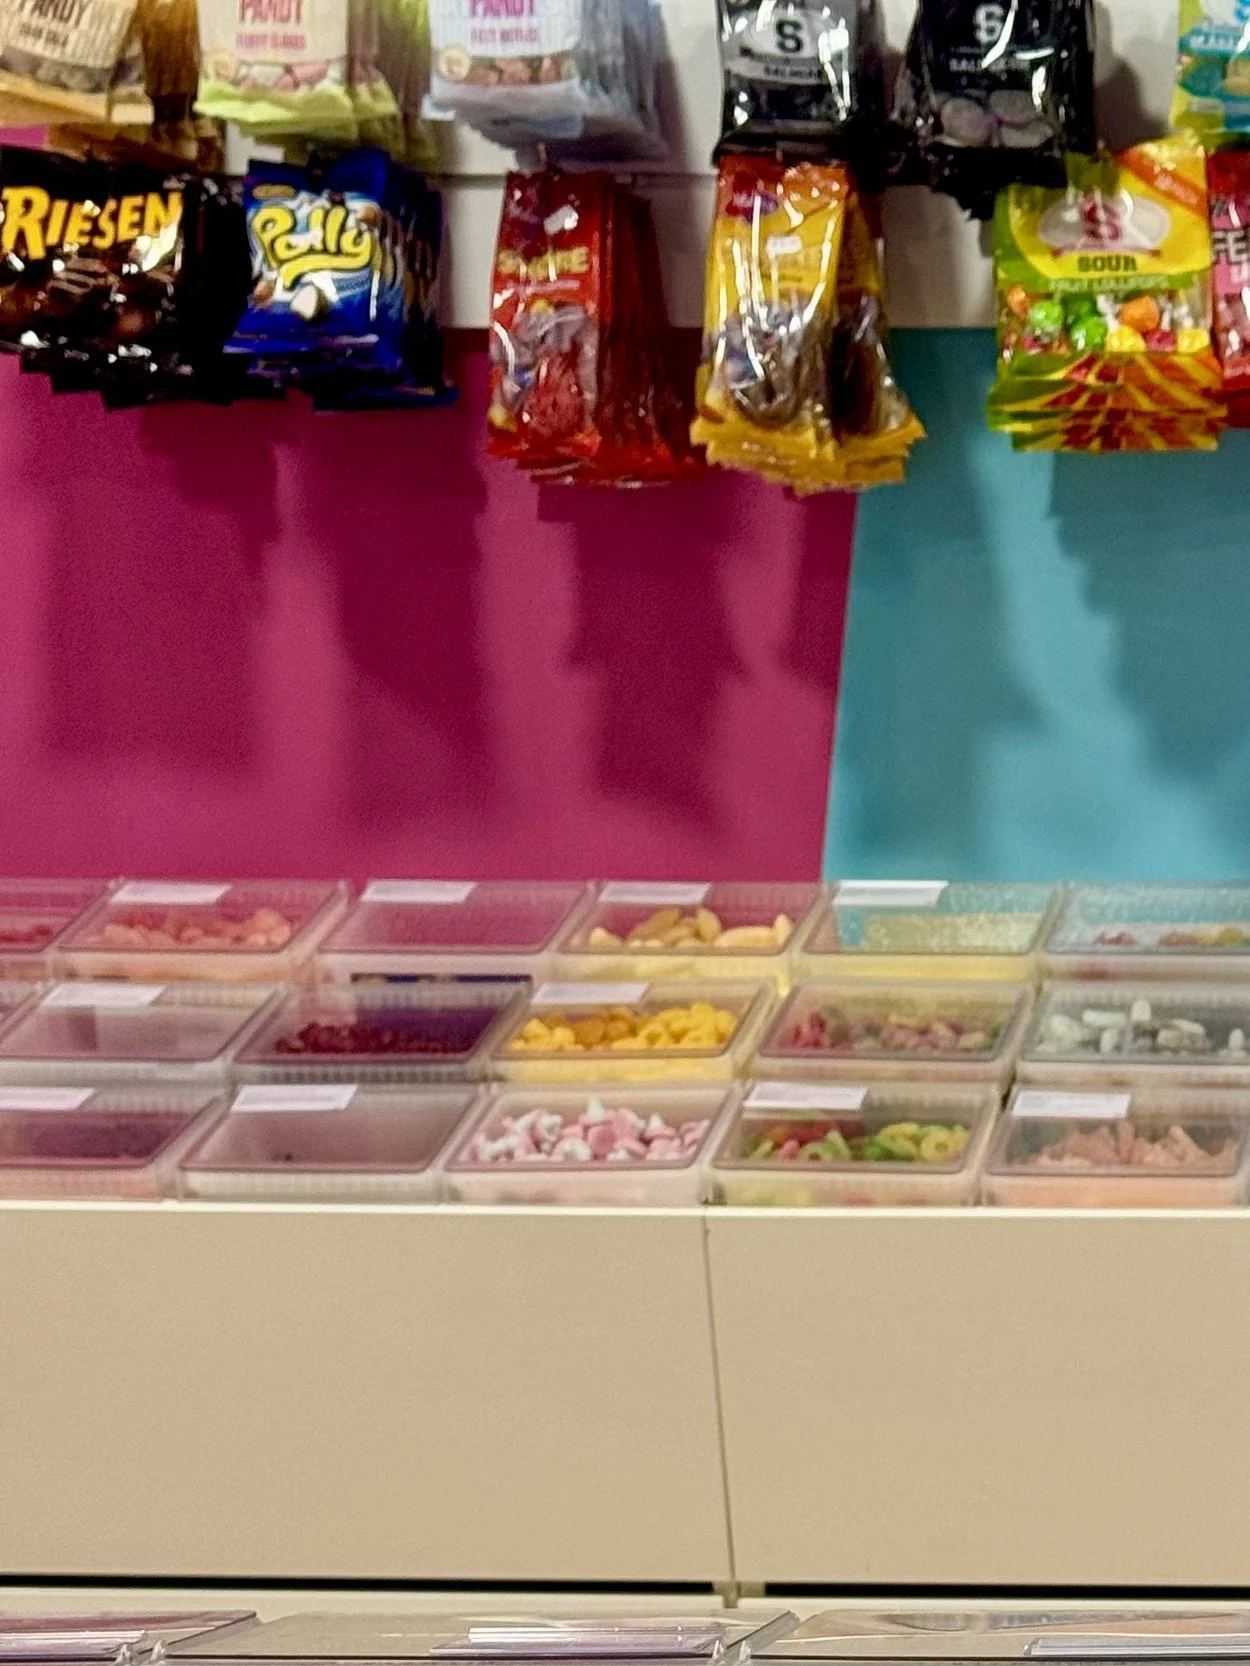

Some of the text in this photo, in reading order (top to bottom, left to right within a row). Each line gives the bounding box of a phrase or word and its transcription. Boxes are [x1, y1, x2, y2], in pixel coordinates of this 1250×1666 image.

[776, 19, 803, 53] S
[1, 186, 182, 260] RIESEN
[252, 206, 373, 290] Polly
[1077, 254, 1137, 272] SOUR
